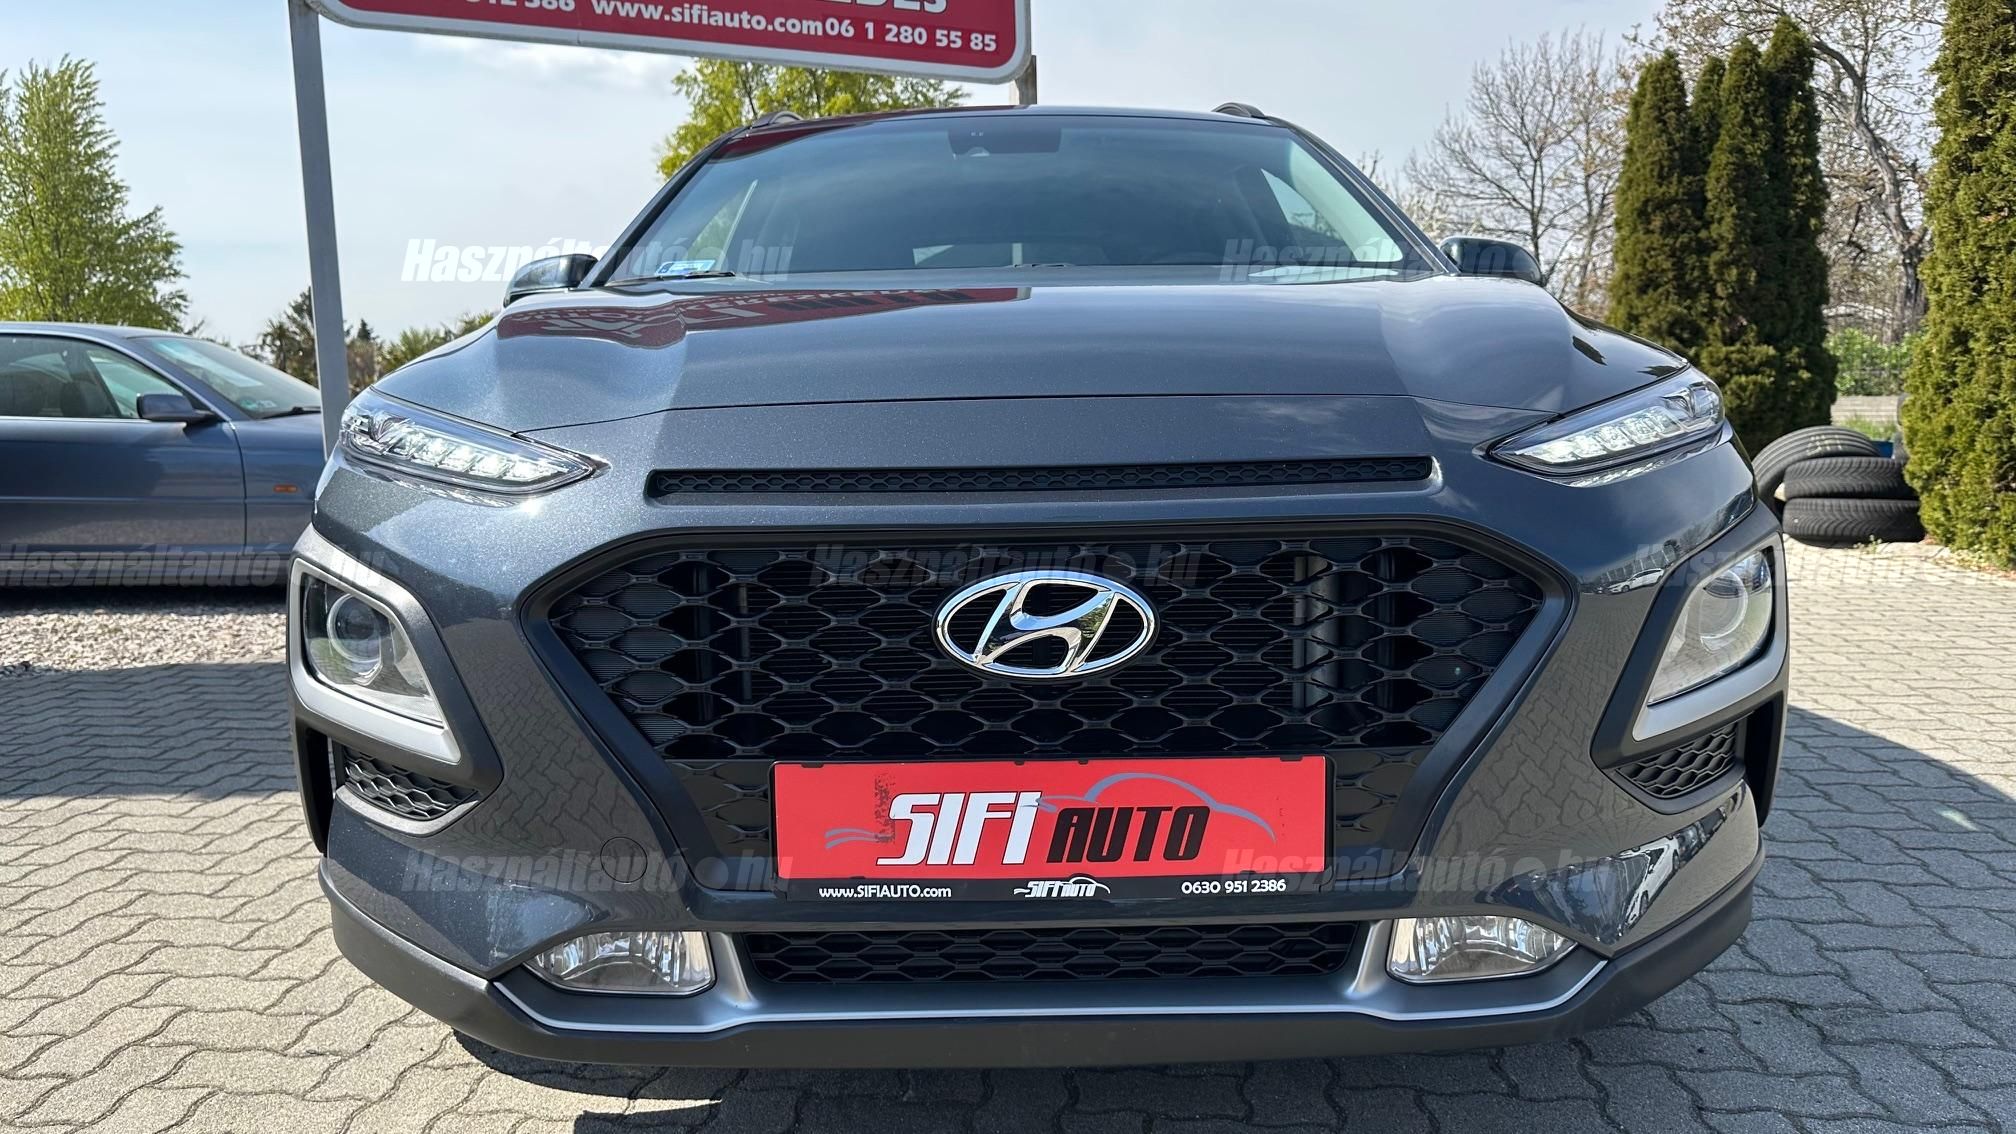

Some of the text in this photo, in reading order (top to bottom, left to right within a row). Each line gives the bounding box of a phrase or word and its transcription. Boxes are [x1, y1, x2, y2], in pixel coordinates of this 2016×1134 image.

[591, 0, 823, 36] www.sifiauto.com
[825, 17, 855, 38] 06
[864, 22, 875, 40] 1
[884, 24, 928, 45] 280
[935, 29, 962, 48] 55
[969, 33, 997, 52] 85
[876, 790, 1211, 866] SIFI AUTO
[818, 885, 952, 898] www.SIFIAUTO.com
[1181, 879, 1287, 894] 0630 951 2386
